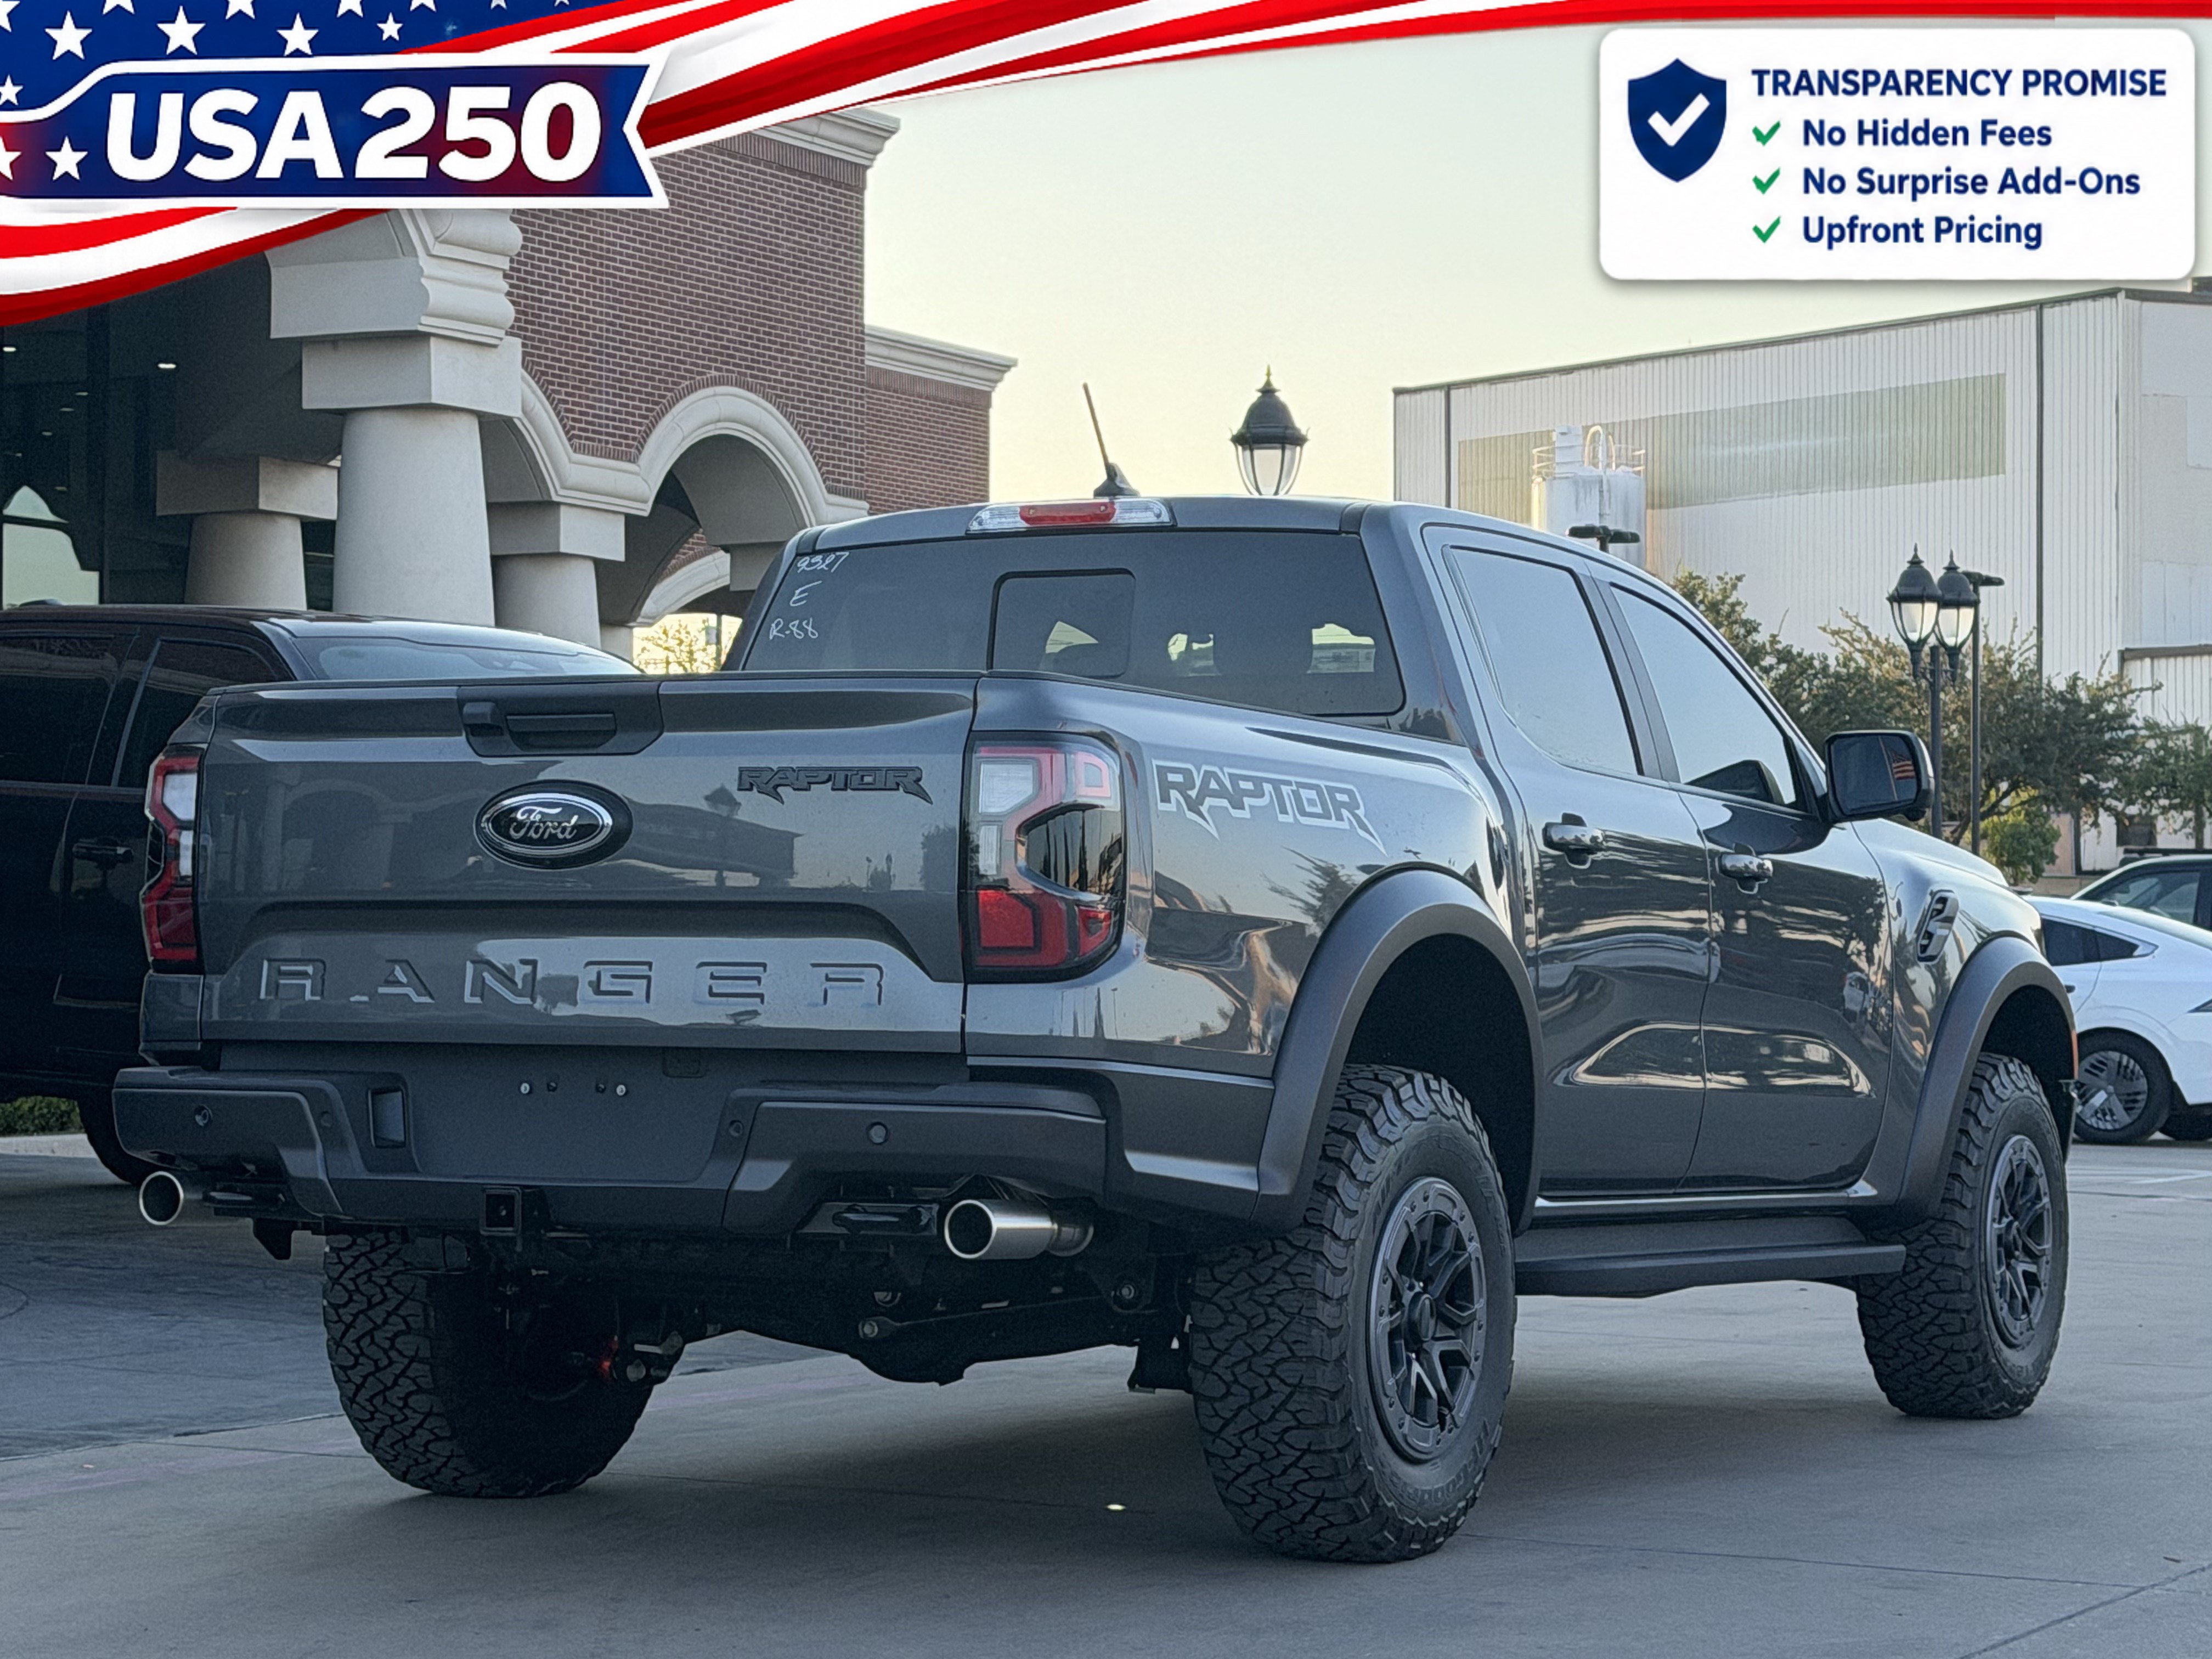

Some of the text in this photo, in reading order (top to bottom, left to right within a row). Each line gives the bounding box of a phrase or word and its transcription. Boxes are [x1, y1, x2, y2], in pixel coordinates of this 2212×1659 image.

[789, 580, 822, 607] E
[737, 766, 933, 805] RAPTOR
[509, 806, 579, 840] Ford
[1152, 759, 1389, 857] RAPTOR
[259, 958, 883, 1008] RANGER
